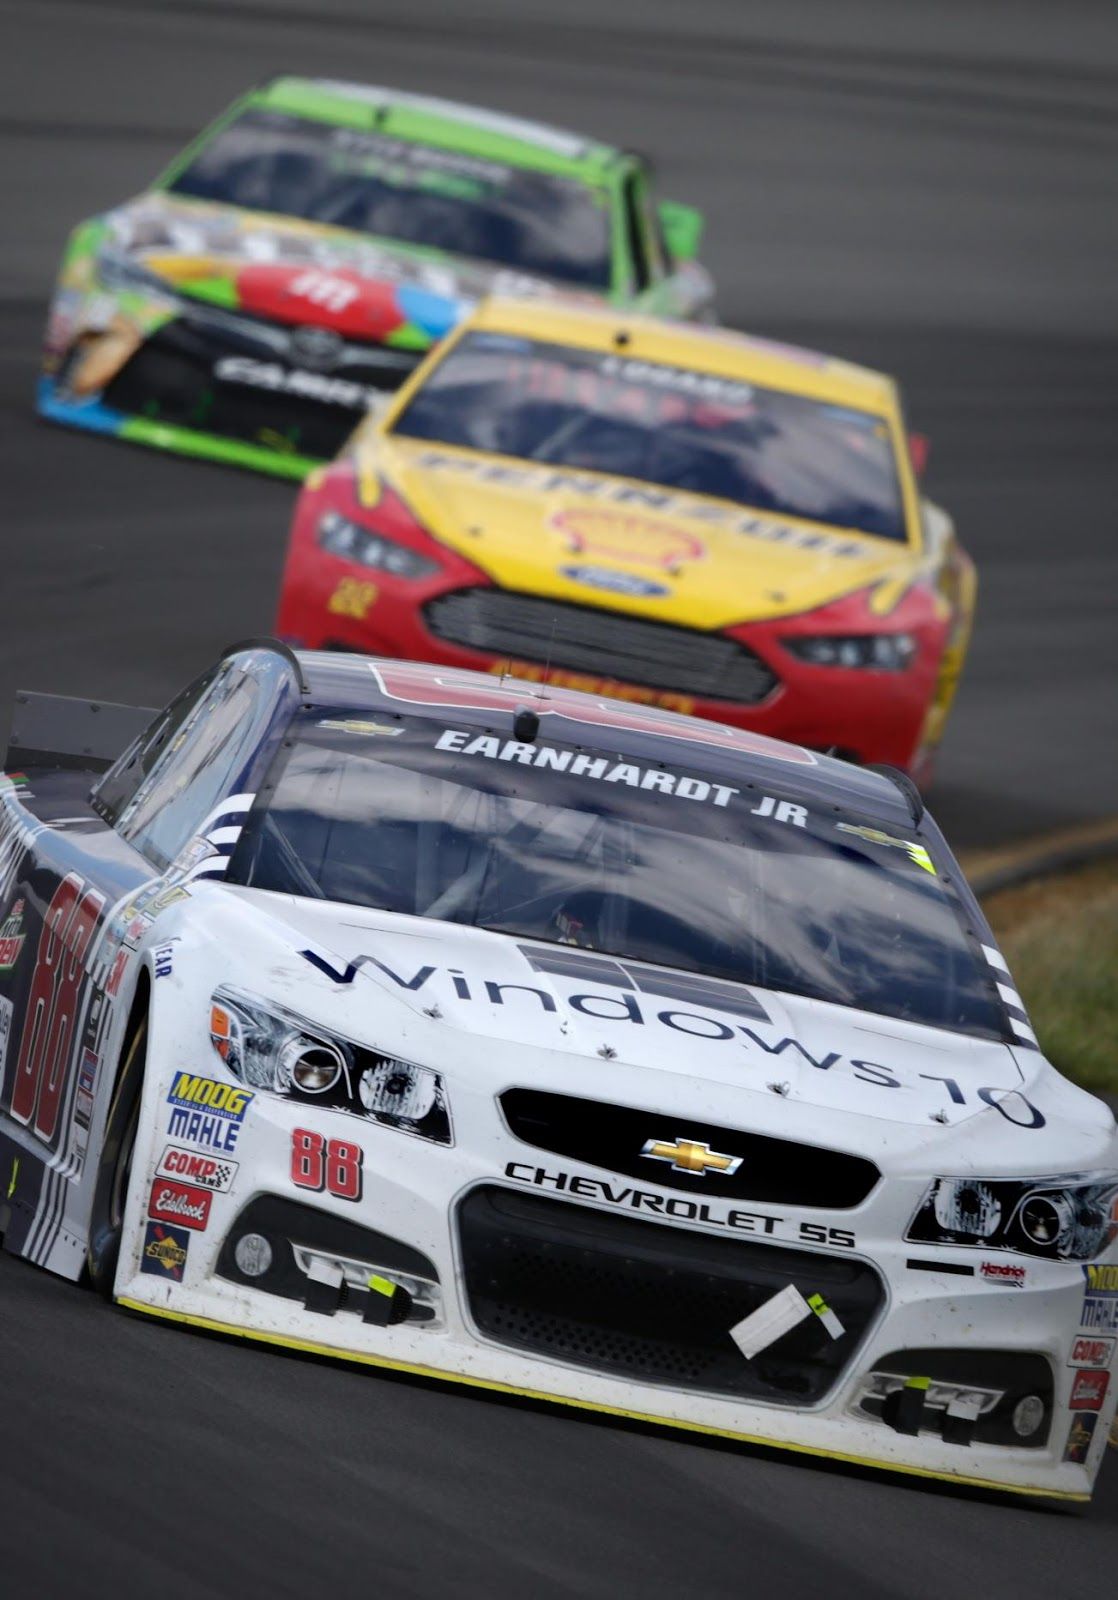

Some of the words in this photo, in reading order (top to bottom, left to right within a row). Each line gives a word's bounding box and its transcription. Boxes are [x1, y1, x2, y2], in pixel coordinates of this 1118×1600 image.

[434, 727, 740, 809] EARNHARDT
[750, 794, 811, 830] JR
[9, 870, 107, 1144] 88
[298, 948, 904, 1092] Windows
[917, 1072, 1047, 1130] 10
[171, 1073, 254, 1115] MOOG
[167, 1107, 241, 1152] MAHLE
[162, 1150, 216, 1178] COMP
[289, 1127, 364, 1203] 88
[155, 1188, 207, 1222] Edelbrock
[505, 1160, 784, 1235] CHEVROLET
[798, 1222, 857, 1249] SS
[145, 1241, 187, 1267] SUNOCO
[980, 1261, 1027, 1279] Hendrick
